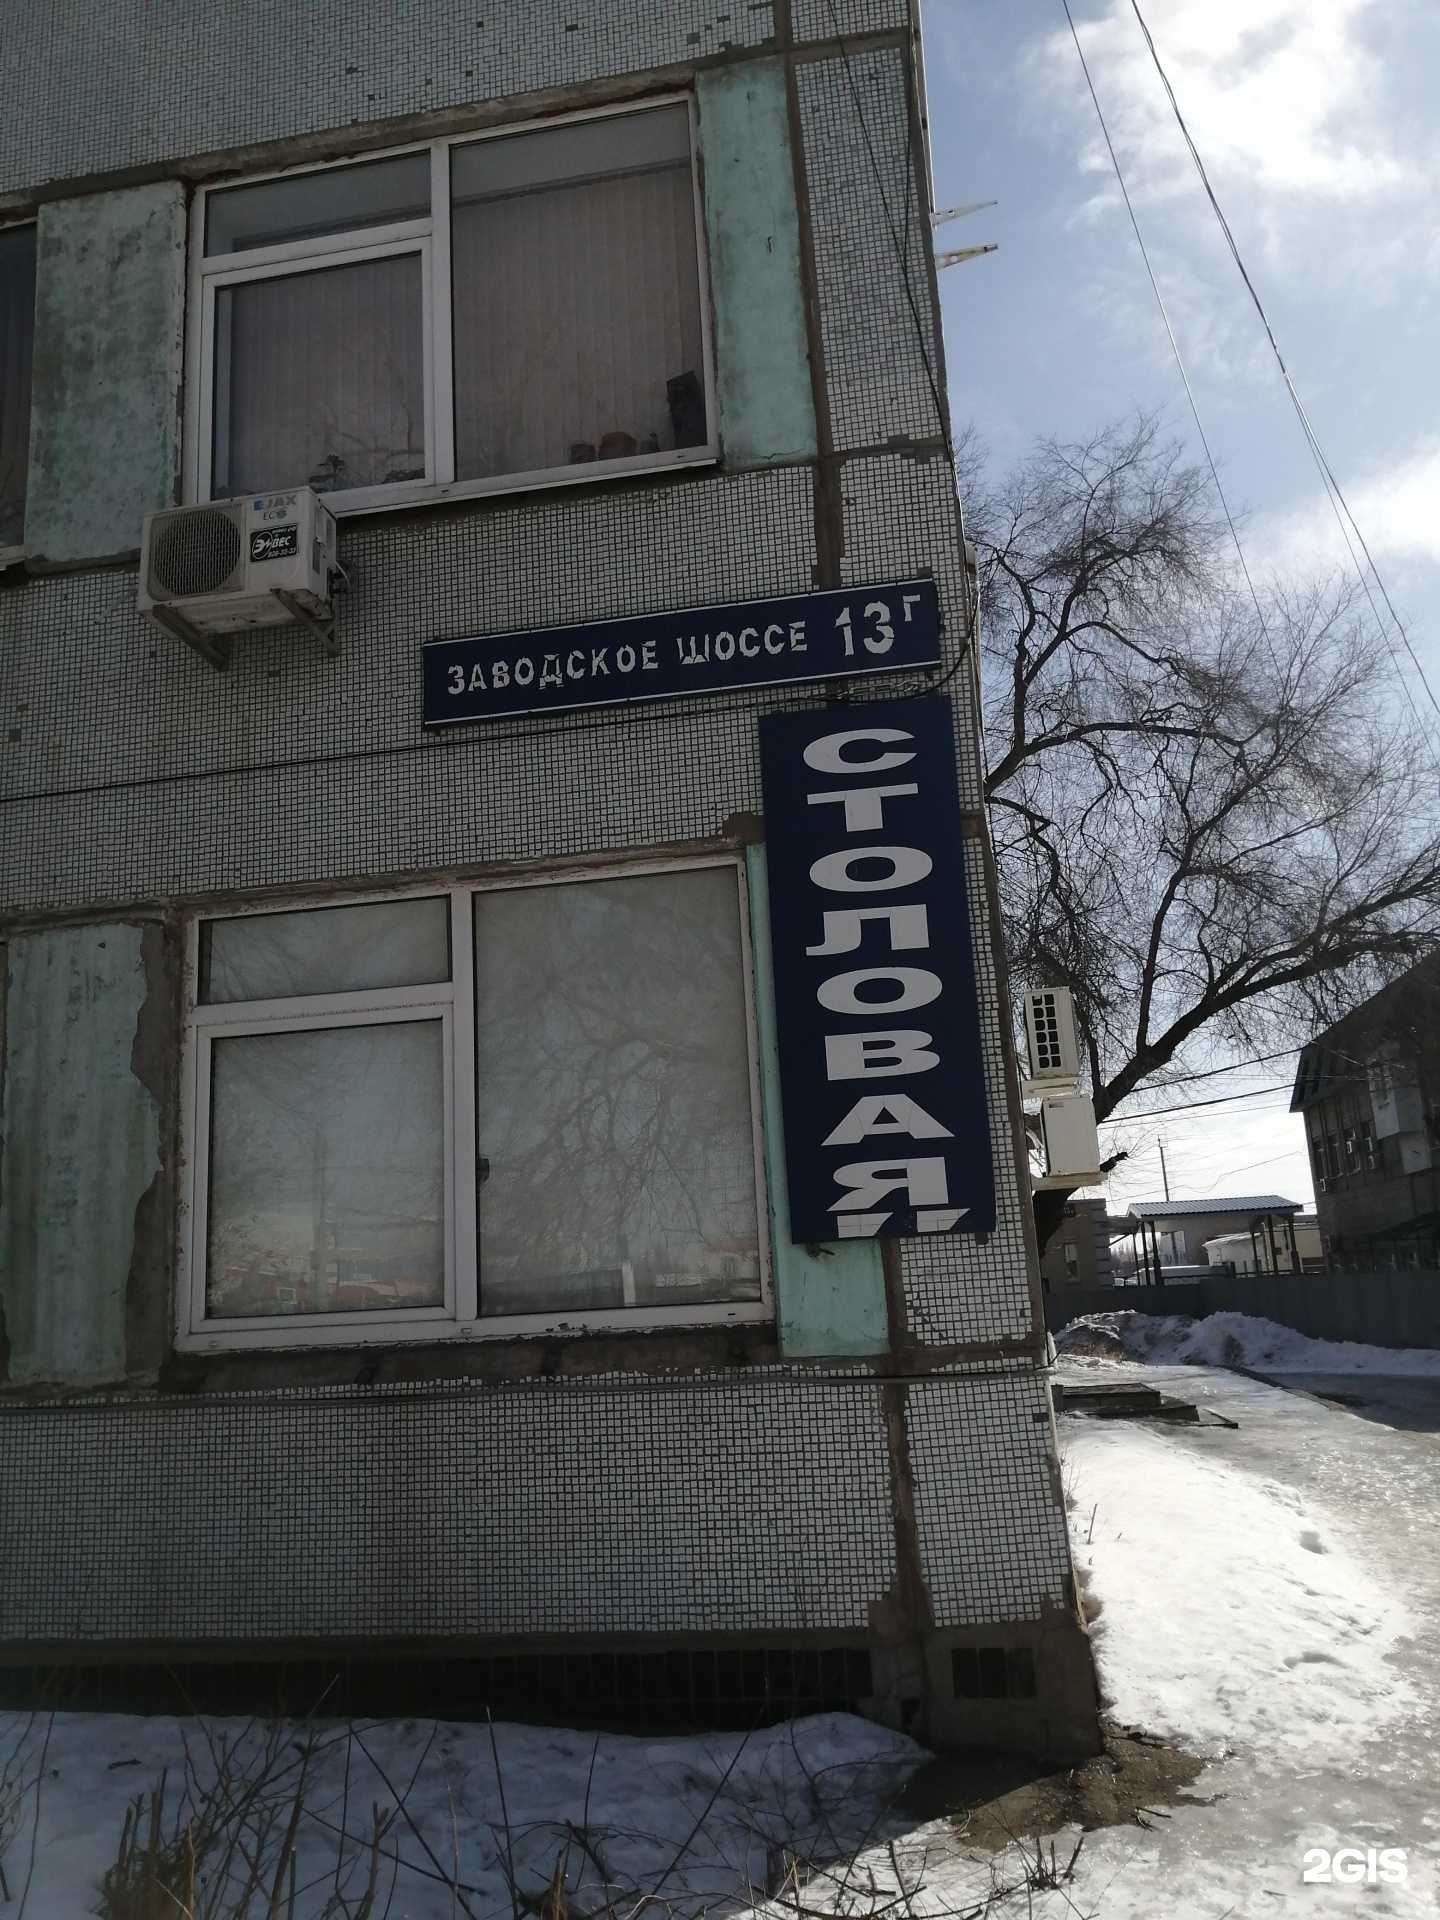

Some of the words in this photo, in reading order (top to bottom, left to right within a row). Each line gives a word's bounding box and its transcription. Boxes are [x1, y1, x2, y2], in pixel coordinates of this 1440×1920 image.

[447, 639, 660, 695] ЗАВОДСКОЕ
[676, 620, 807, 665] ШОССЕ
[803, 728, 955, 1211] СТОЛОВАЯ
